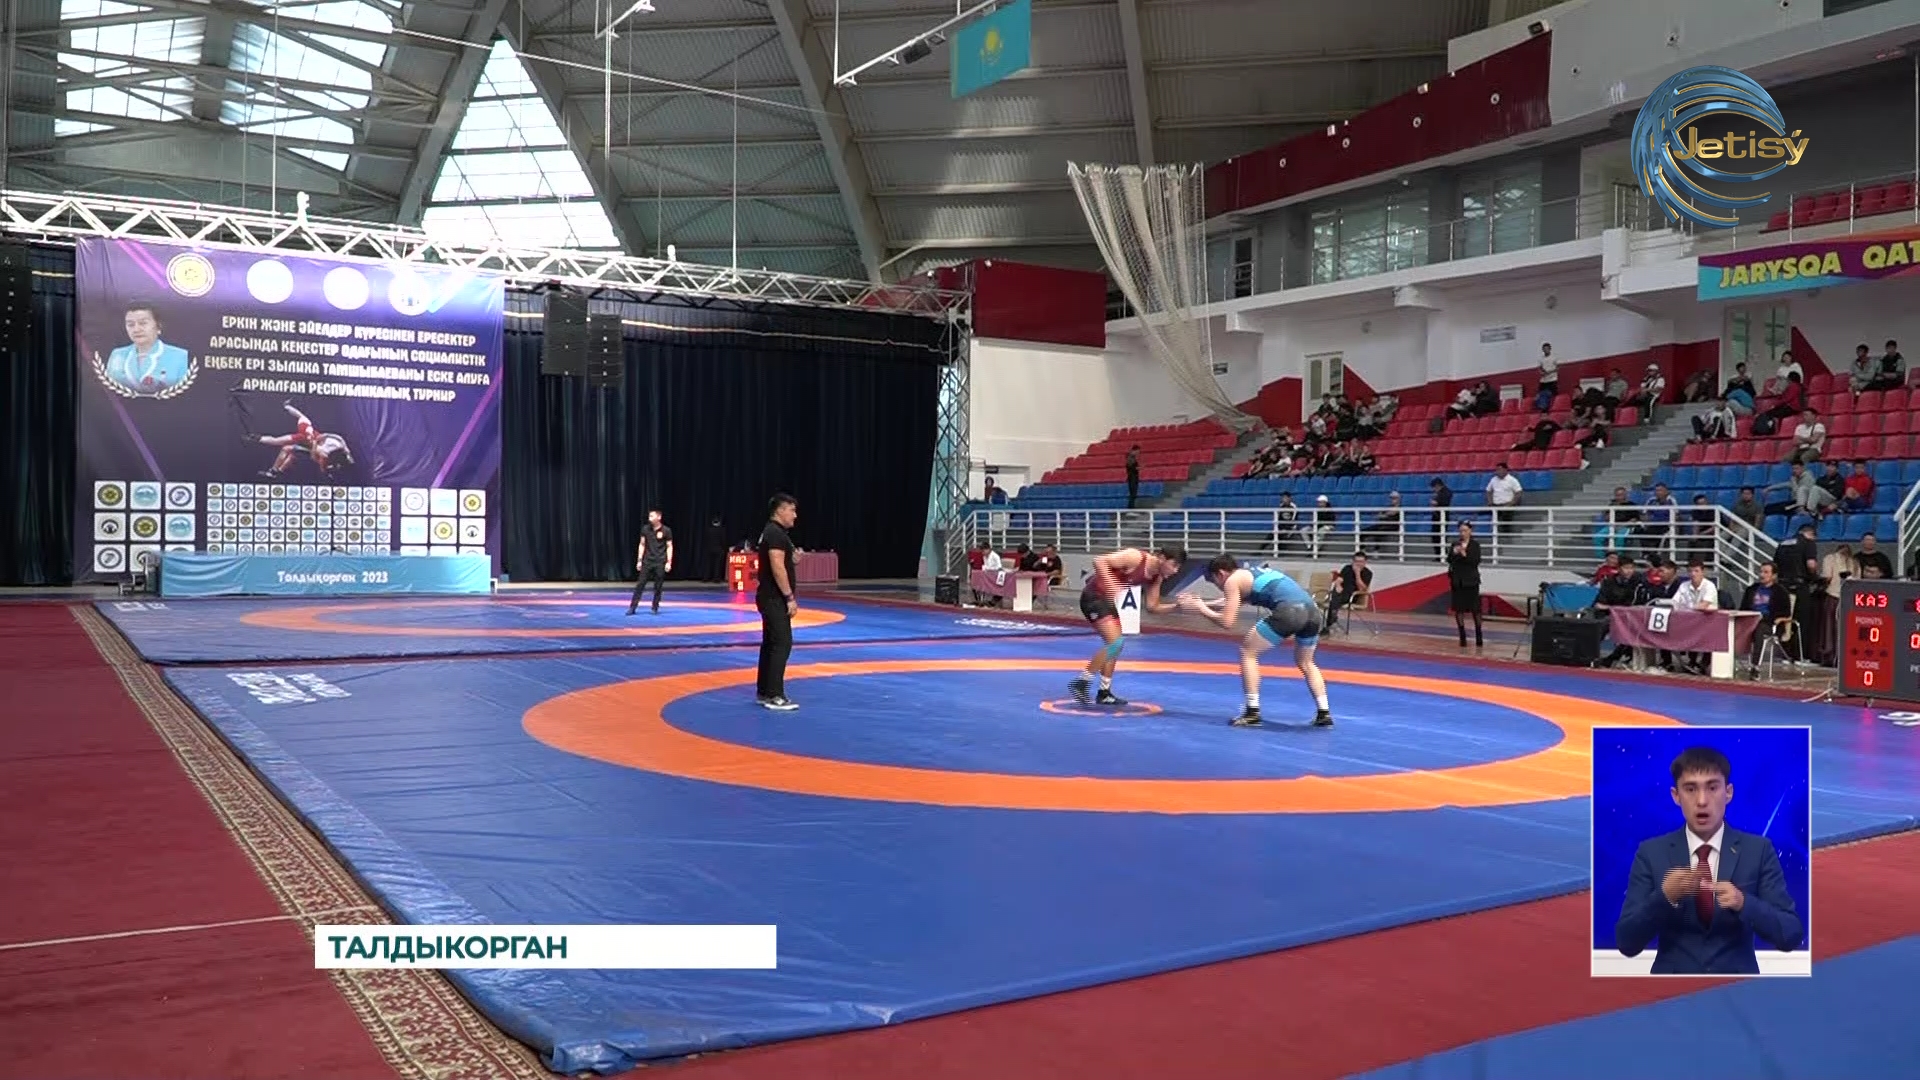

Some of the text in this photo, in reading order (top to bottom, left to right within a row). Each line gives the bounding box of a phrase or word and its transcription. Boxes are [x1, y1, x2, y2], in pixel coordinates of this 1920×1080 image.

[1719, 251, 1843, 289] JARYSQA
[222, 315, 476, 347] ЕРКІН ЖӘНЕ ӘЙЕЛДЕР КҮРЕСІНЕН ЕРЕСЕКТЕР
[210, 336, 486, 366] АРАСЫНДА КЕҢЕСТЕР ОДАҒЫНЫҢ СОЦИАЛИСТІК
[204, 355, 242, 370] ЕҢБЕК
[246, 358, 264, 371] ЕРІ
[268, 359, 319, 375] ЗЫЛИХА
[427, 370, 454, 383] ЕСКЕ
[456, 372, 490, 385] АЛУҒА
[243, 378, 456, 402] АРНАЛҒАН РЕСПУБЛИКАЛЫҚ ТУРНИР
[277, 571, 389, 585] Талдықорған 2023
[1121, 587, 1138, 610] A
[1653, 612, 1665, 630] B
[1855, 615, 1883, 626] POINTS
[1869, 627, 1880, 642] 0
[1856, 660, 1880, 670] SCORE
[1863, 670, 1874, 686] 0
